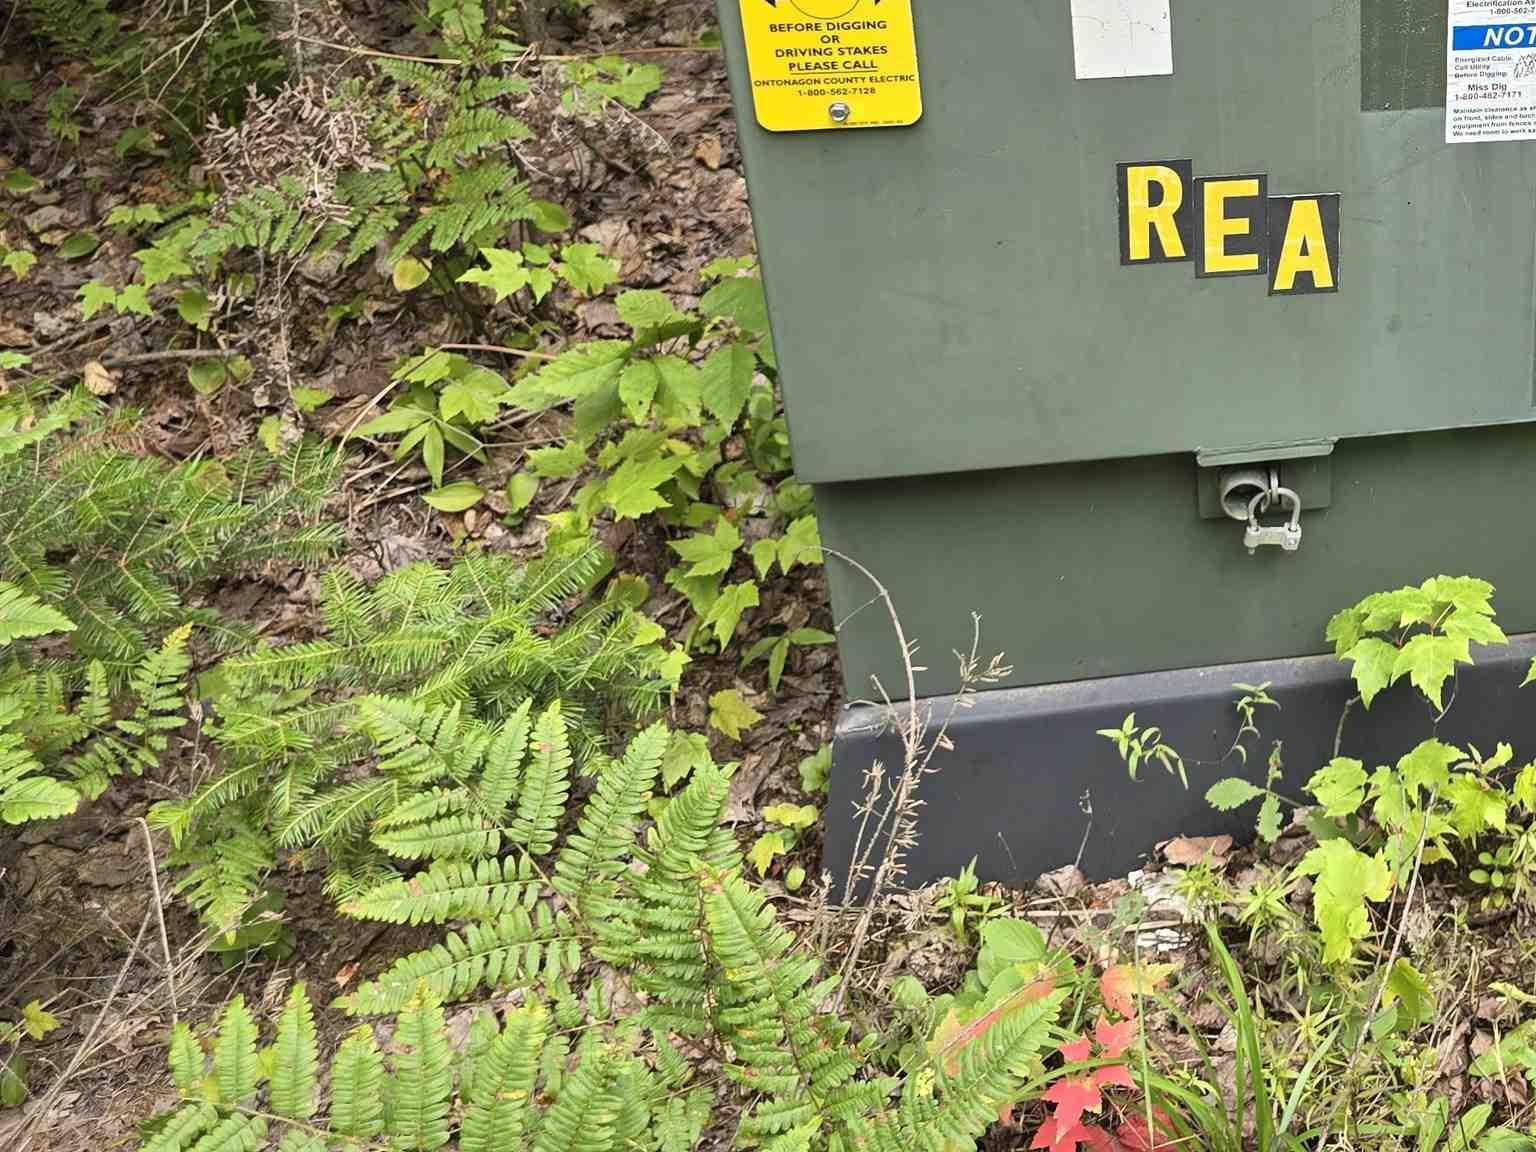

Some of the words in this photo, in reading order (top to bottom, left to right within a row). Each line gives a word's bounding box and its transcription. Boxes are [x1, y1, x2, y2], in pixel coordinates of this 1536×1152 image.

[1466, 0, 1523, 8] Electrification
[769, 22, 823, 33] BEFORE
[826, 20, 887, 31] DIGGING
[820, 35, 841, 44] OR
[775, 48, 833, 58] DRIVING
[838, 46, 888, 56] STAKES
[788, 61, 839, 72] PLEASE
[842, 59, 878, 70] CALL
[754, 78, 822, 87] ONTONAGON
[823, 76, 866, 85] COUNTY
[869, 74, 916, 83] ELECTRIC
[1467, 83, 1489, 91] Miss
[1491, 82, 1507, 91] Dig
[797, 88, 877, 97] 1-800-562-7128
[1126, 164, 1335, 291] REA
